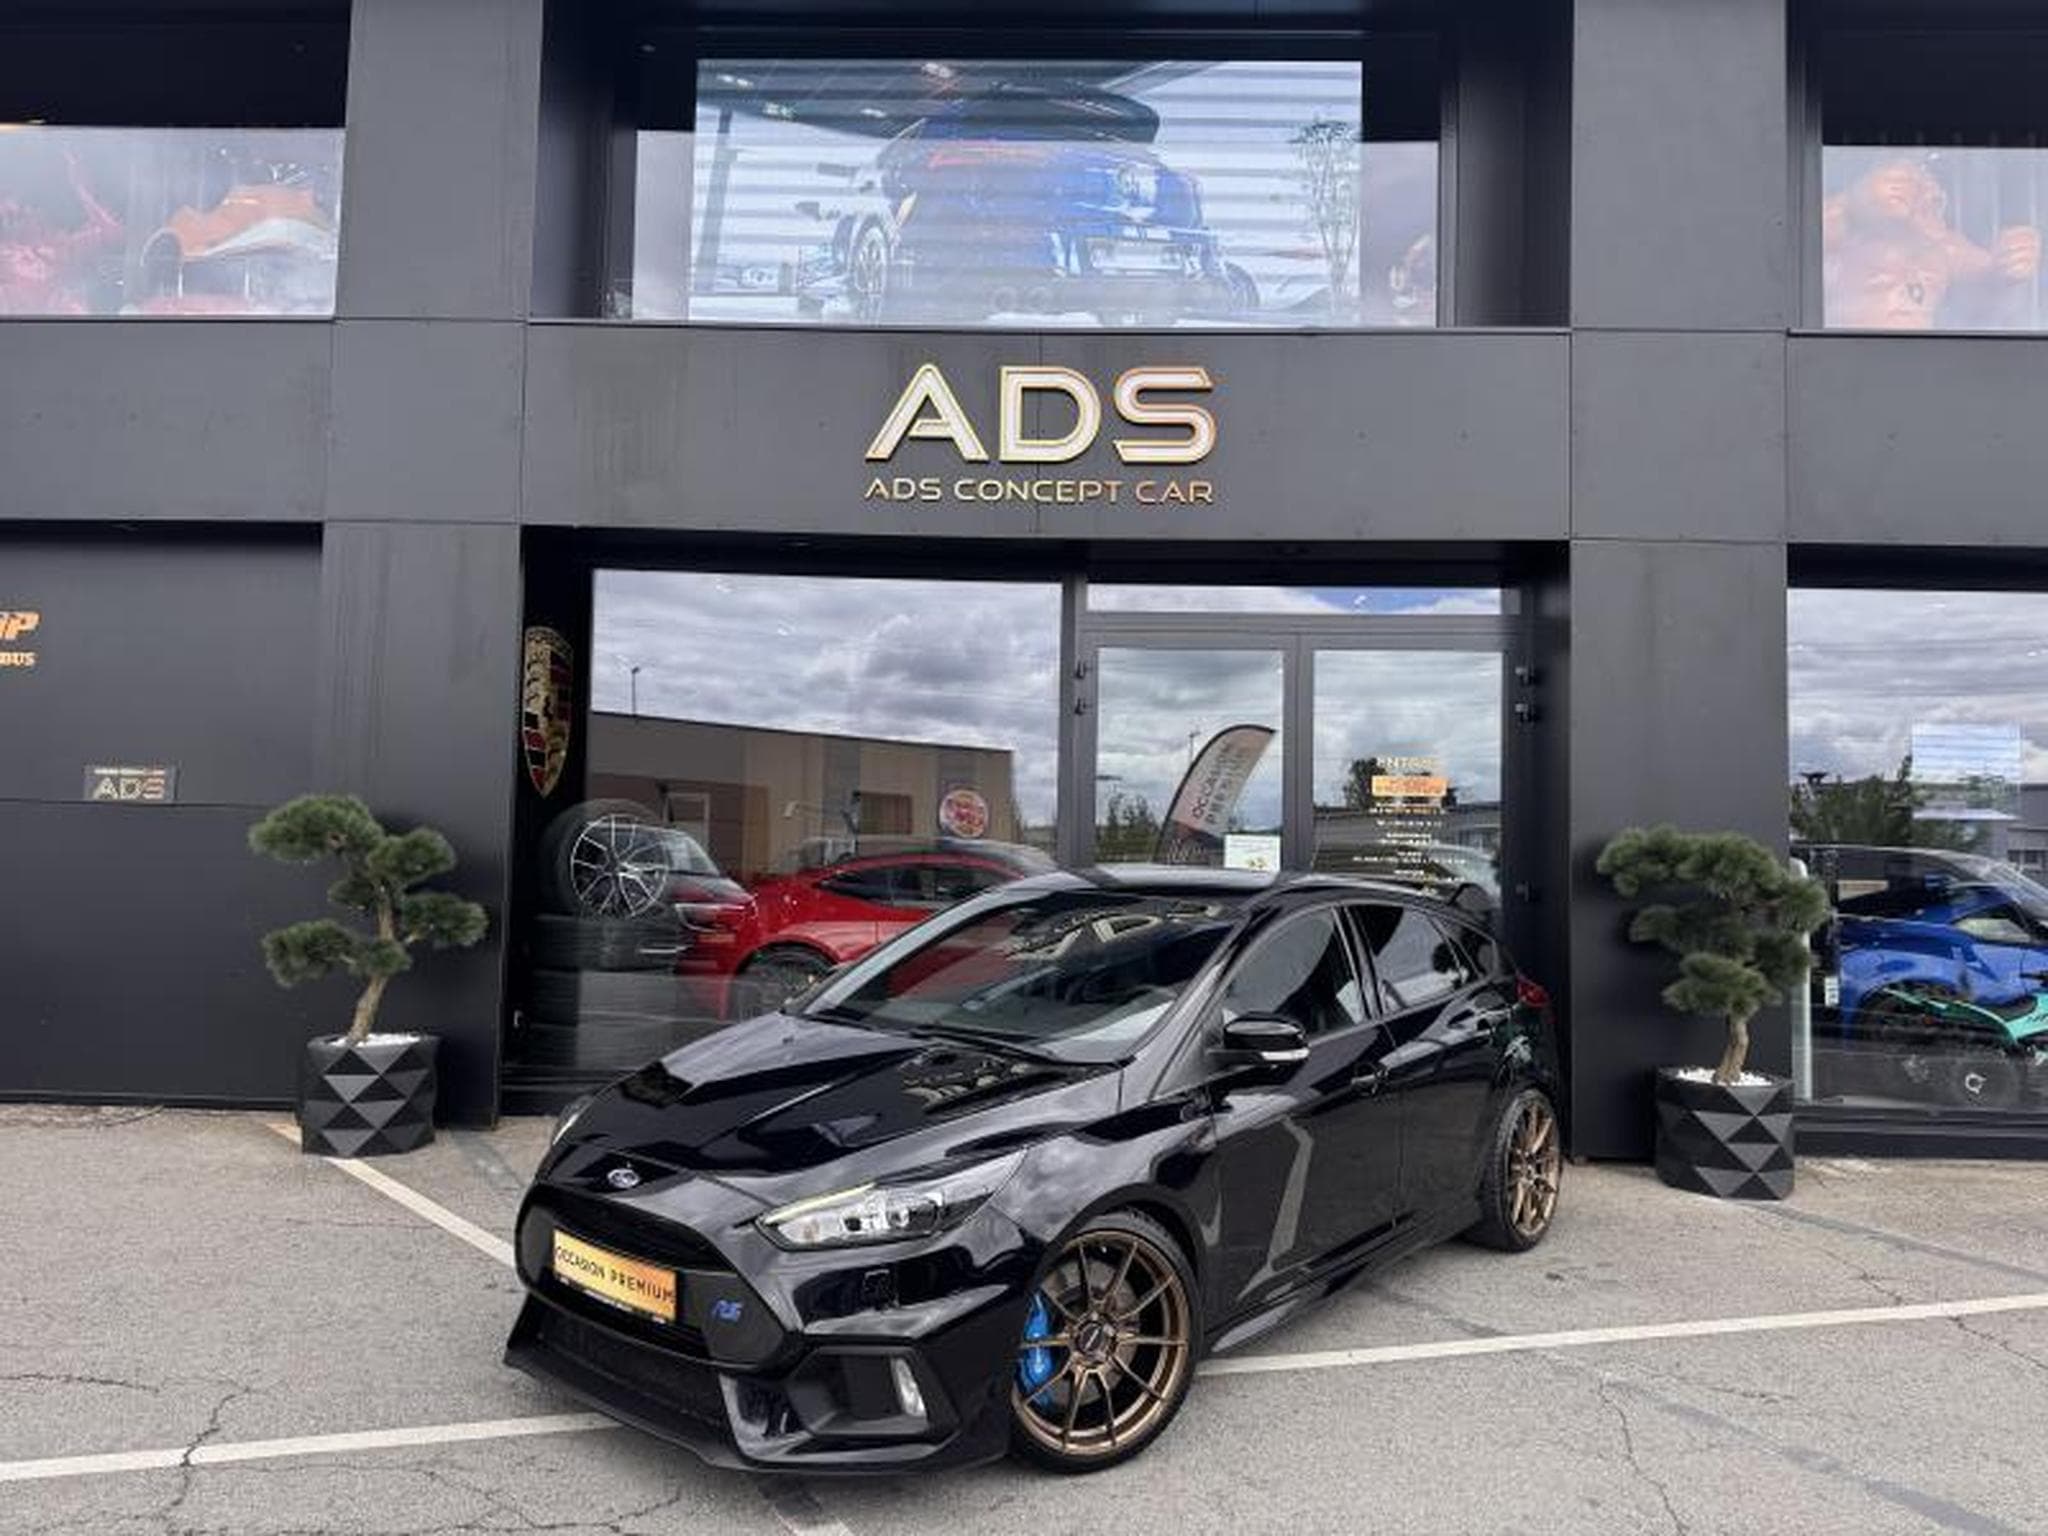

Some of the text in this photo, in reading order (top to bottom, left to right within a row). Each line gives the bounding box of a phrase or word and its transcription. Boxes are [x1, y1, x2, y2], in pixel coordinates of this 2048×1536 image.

[863, 362, 1218, 463] ADS
[864, 477, 1215, 504] ADS CONCEPT CAR
[93, 776, 165, 800] ADS
[554, 1245, 606, 1280] OCCASION
[609, 1268, 675, 1304] PREMIUM
